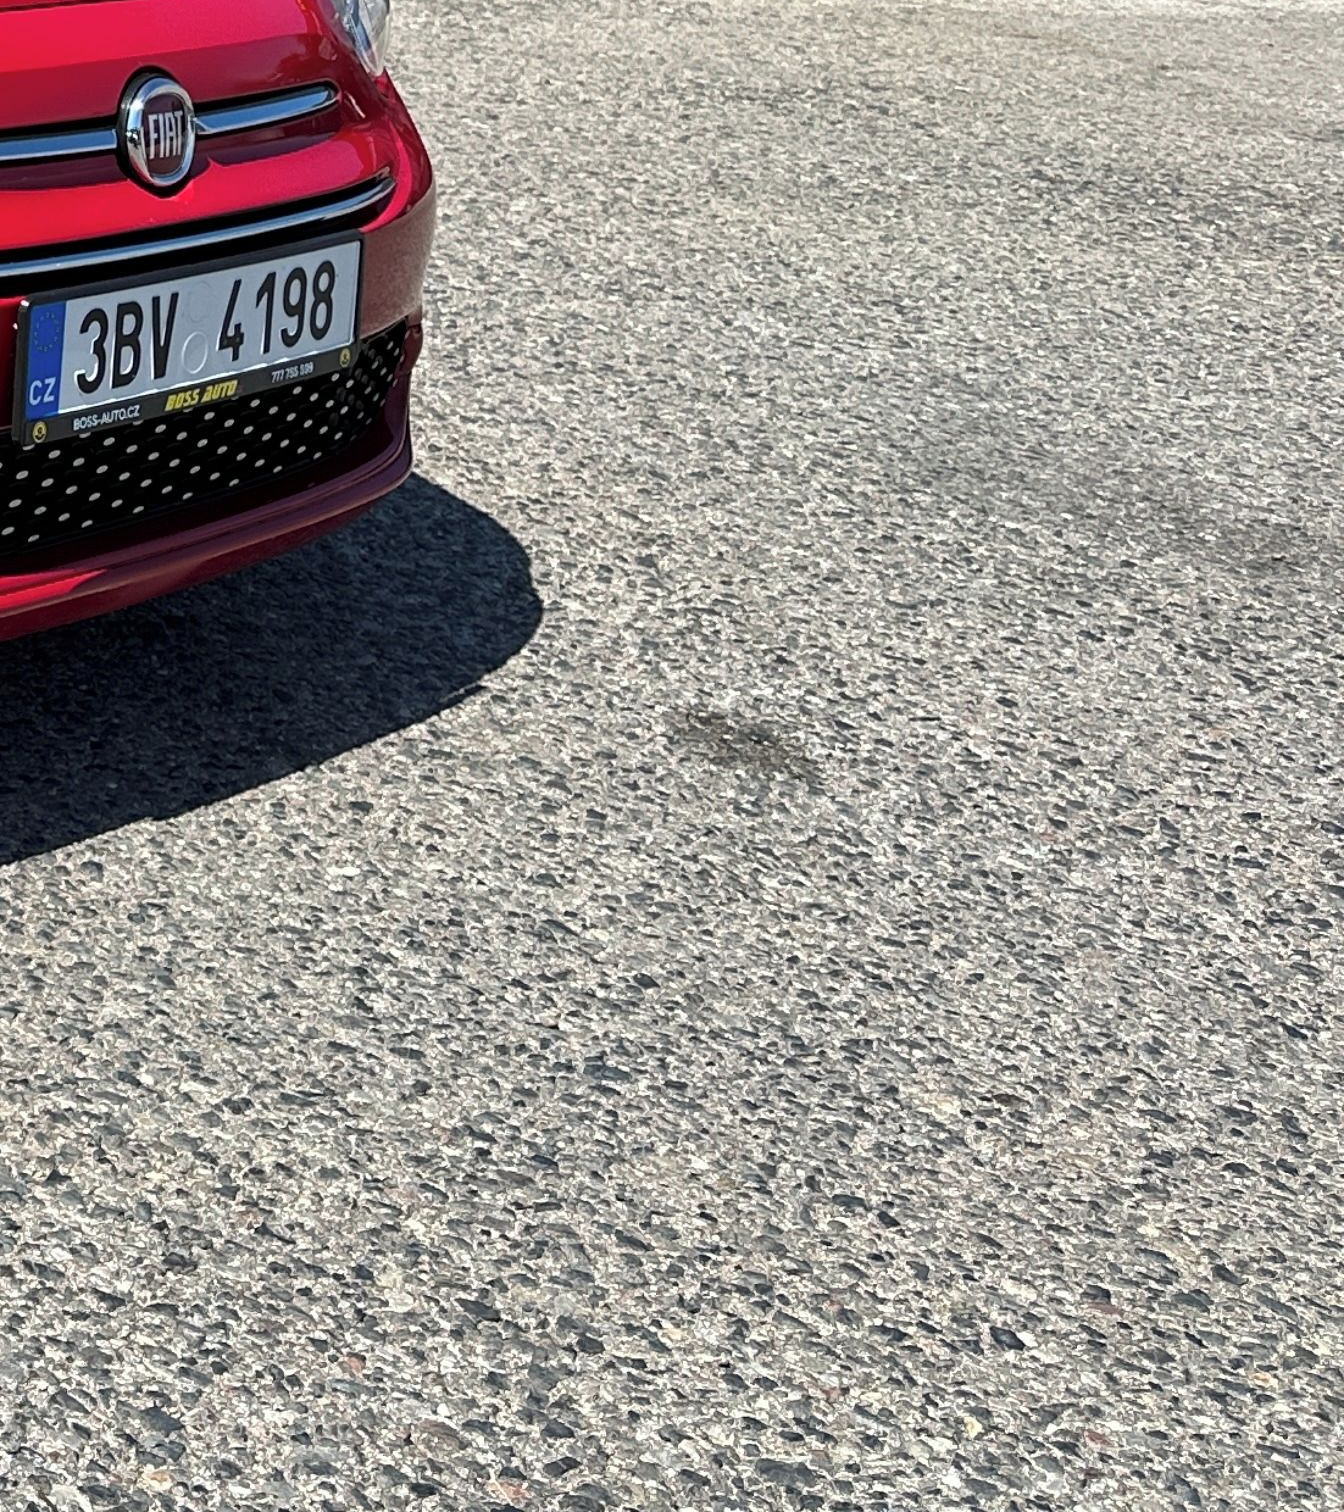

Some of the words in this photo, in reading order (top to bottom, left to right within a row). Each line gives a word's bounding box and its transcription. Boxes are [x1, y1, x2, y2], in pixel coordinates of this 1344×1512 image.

[148, 110, 183, 160] FIAT
[76, 291, 180, 394] 3BV
[216, 260, 335, 362] 4198
[29, 377, 56, 406] CZ
[165, 390, 200, 411] BOSS
[202, 380, 238, 403] AUTO
[73, 405, 141, 431] BOSS-AUTO.CZ
